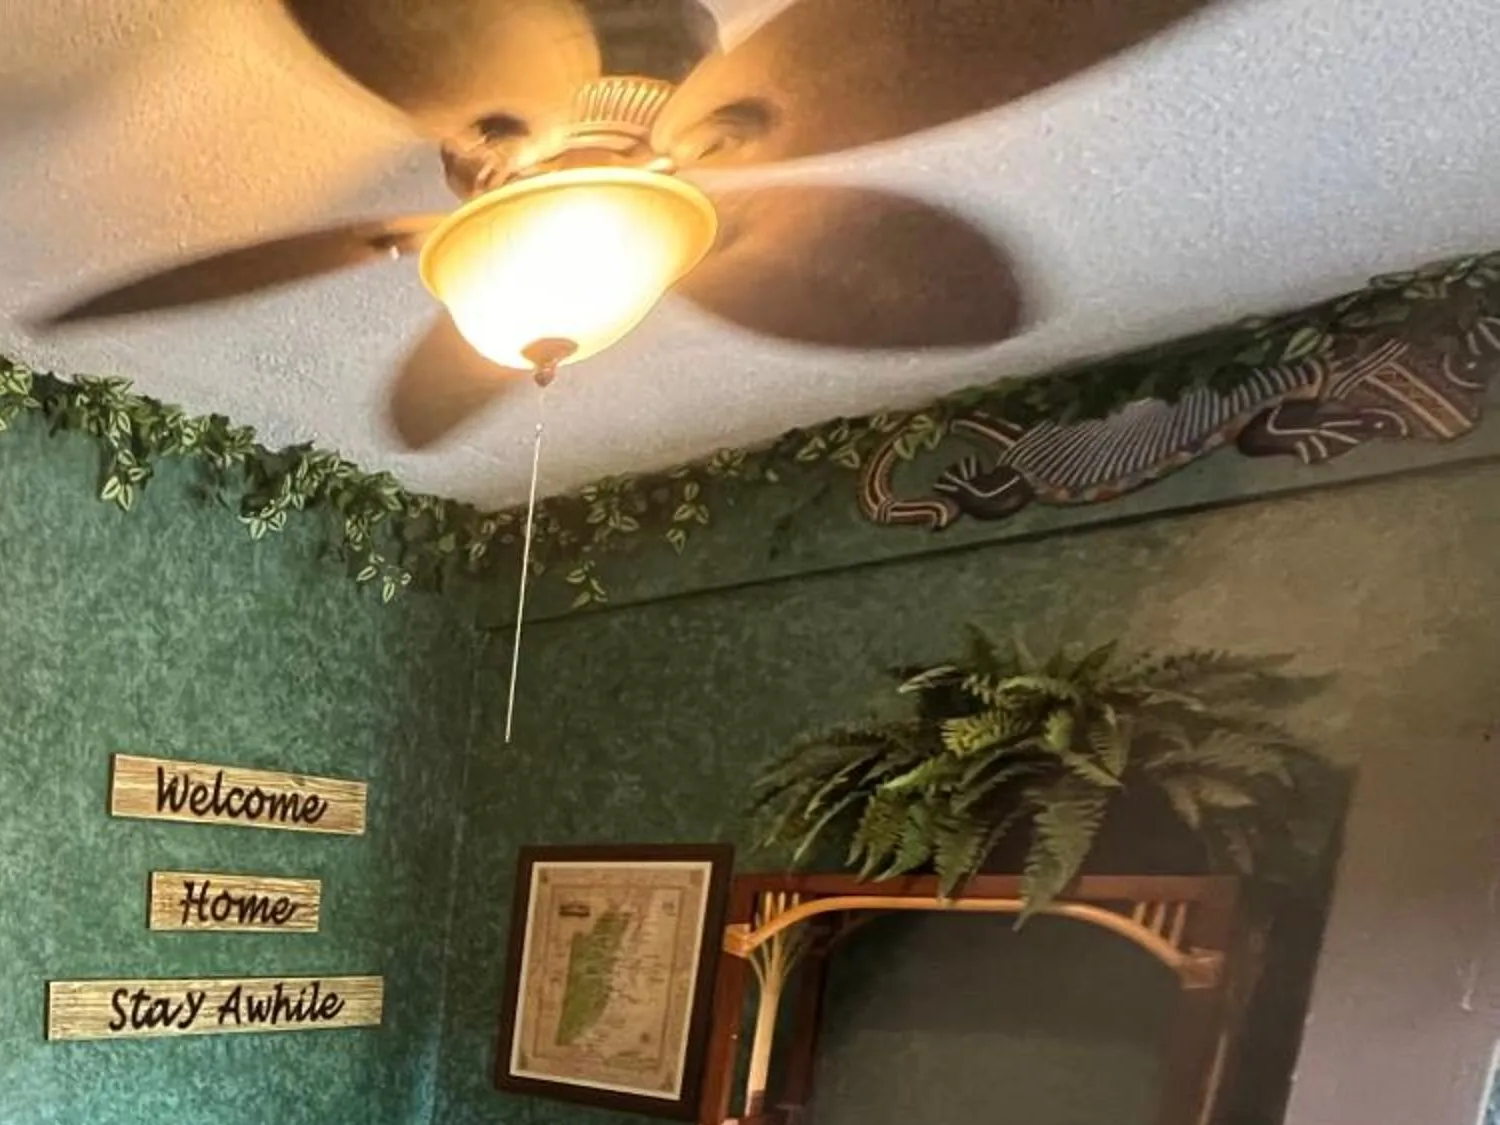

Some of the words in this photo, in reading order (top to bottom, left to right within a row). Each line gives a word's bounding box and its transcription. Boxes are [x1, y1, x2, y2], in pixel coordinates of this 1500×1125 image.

[156, 766, 328, 824] Welcome
[180, 879, 299, 925] Home
[108, 988, 206, 1032] Stay
[217, 981, 345, 1025] Awhile
